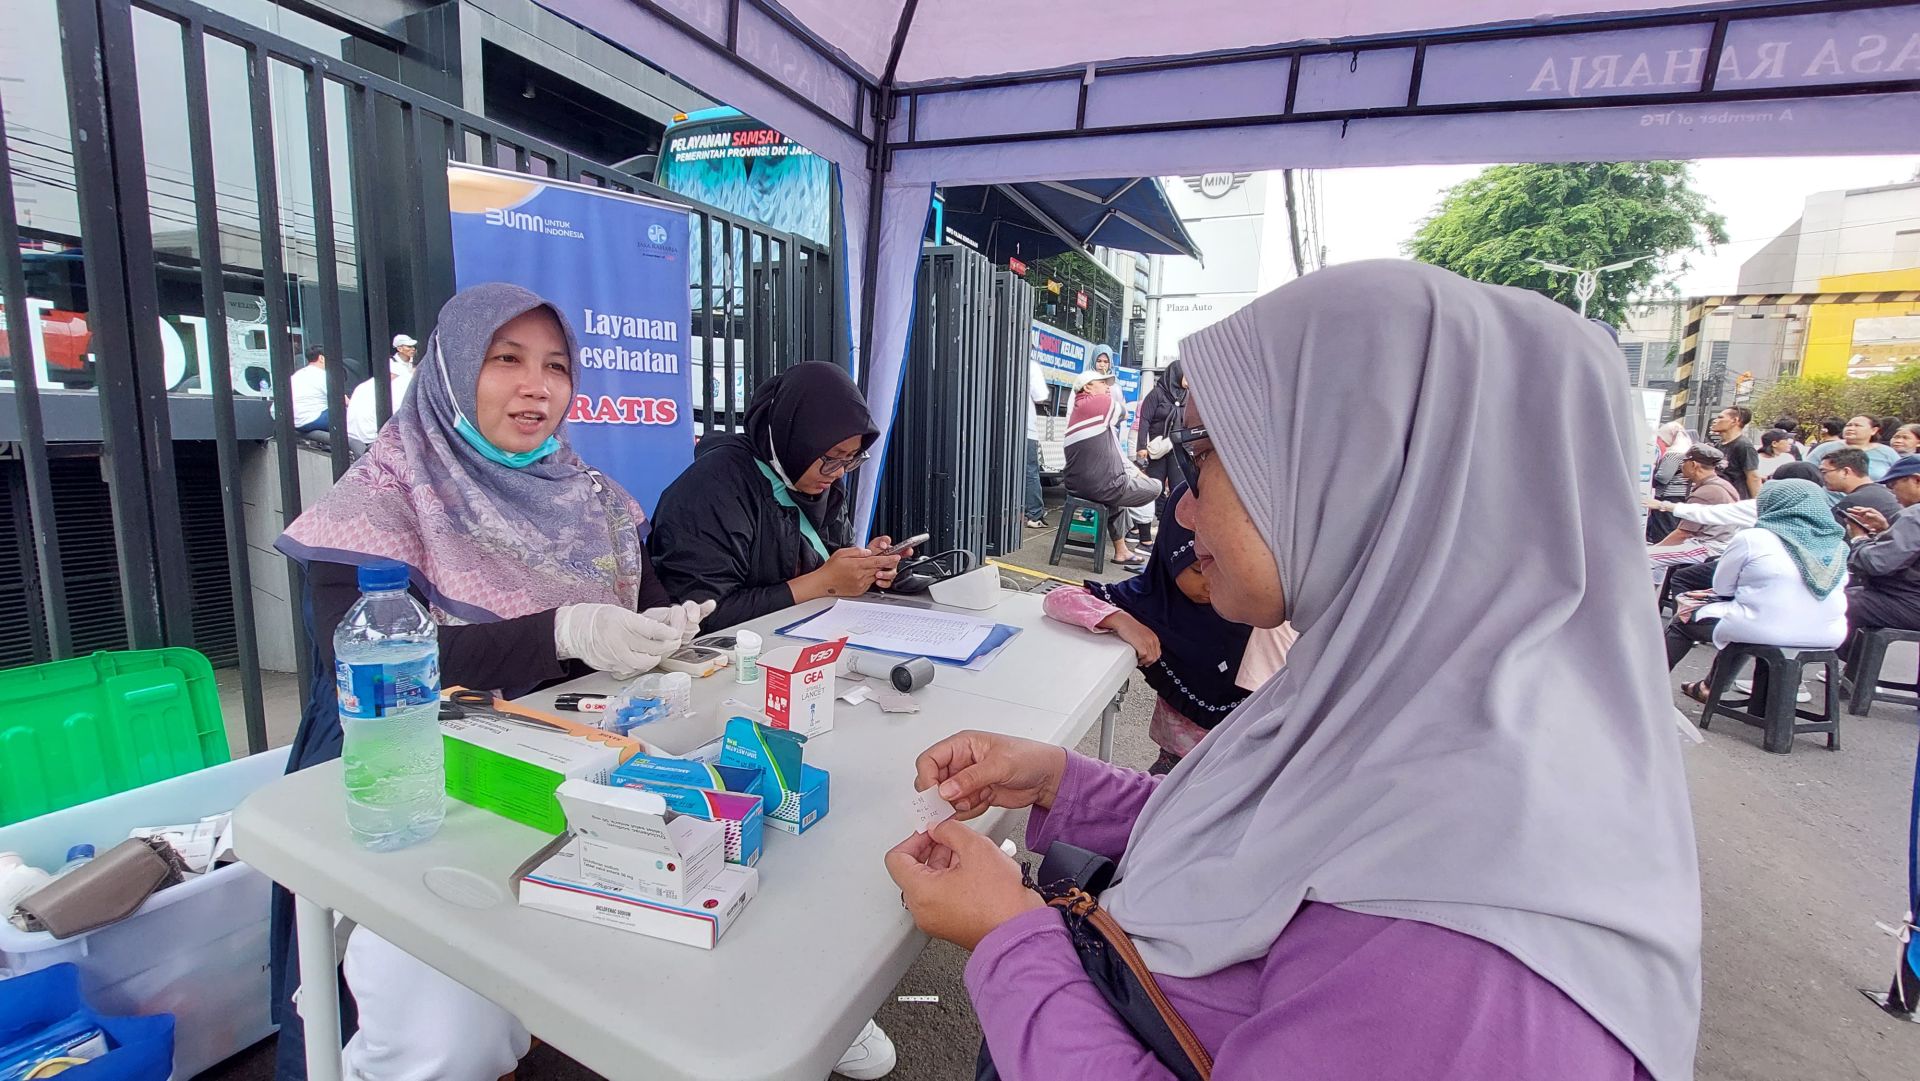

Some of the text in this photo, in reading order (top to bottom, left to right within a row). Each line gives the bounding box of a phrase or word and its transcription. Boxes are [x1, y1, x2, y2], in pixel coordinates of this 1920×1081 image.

[670, 132, 731, 152] PELAYANAN
[731, 130, 781, 147] SAMSAT
[675, 149, 725, 162] PEMERINTAH
[727, 146, 770, 158] PROVINSI
[771, 146, 788, 155] DKI
[1204, 176, 1230, 187] MINI
[545, 219, 570, 229] UNTUK
[545, 227, 584, 240] INDONESIA
[1166, 303, 1213, 312] Plaza Auto
[584, 309, 678, 341] Layanan
[580, 346, 679, 374] esehatan
[567, 395, 677, 424] RATIS
[810, 648, 834, 663] GEA
[804, 670, 824, 684] GEA
[801, 688, 825, 701] LANCET
